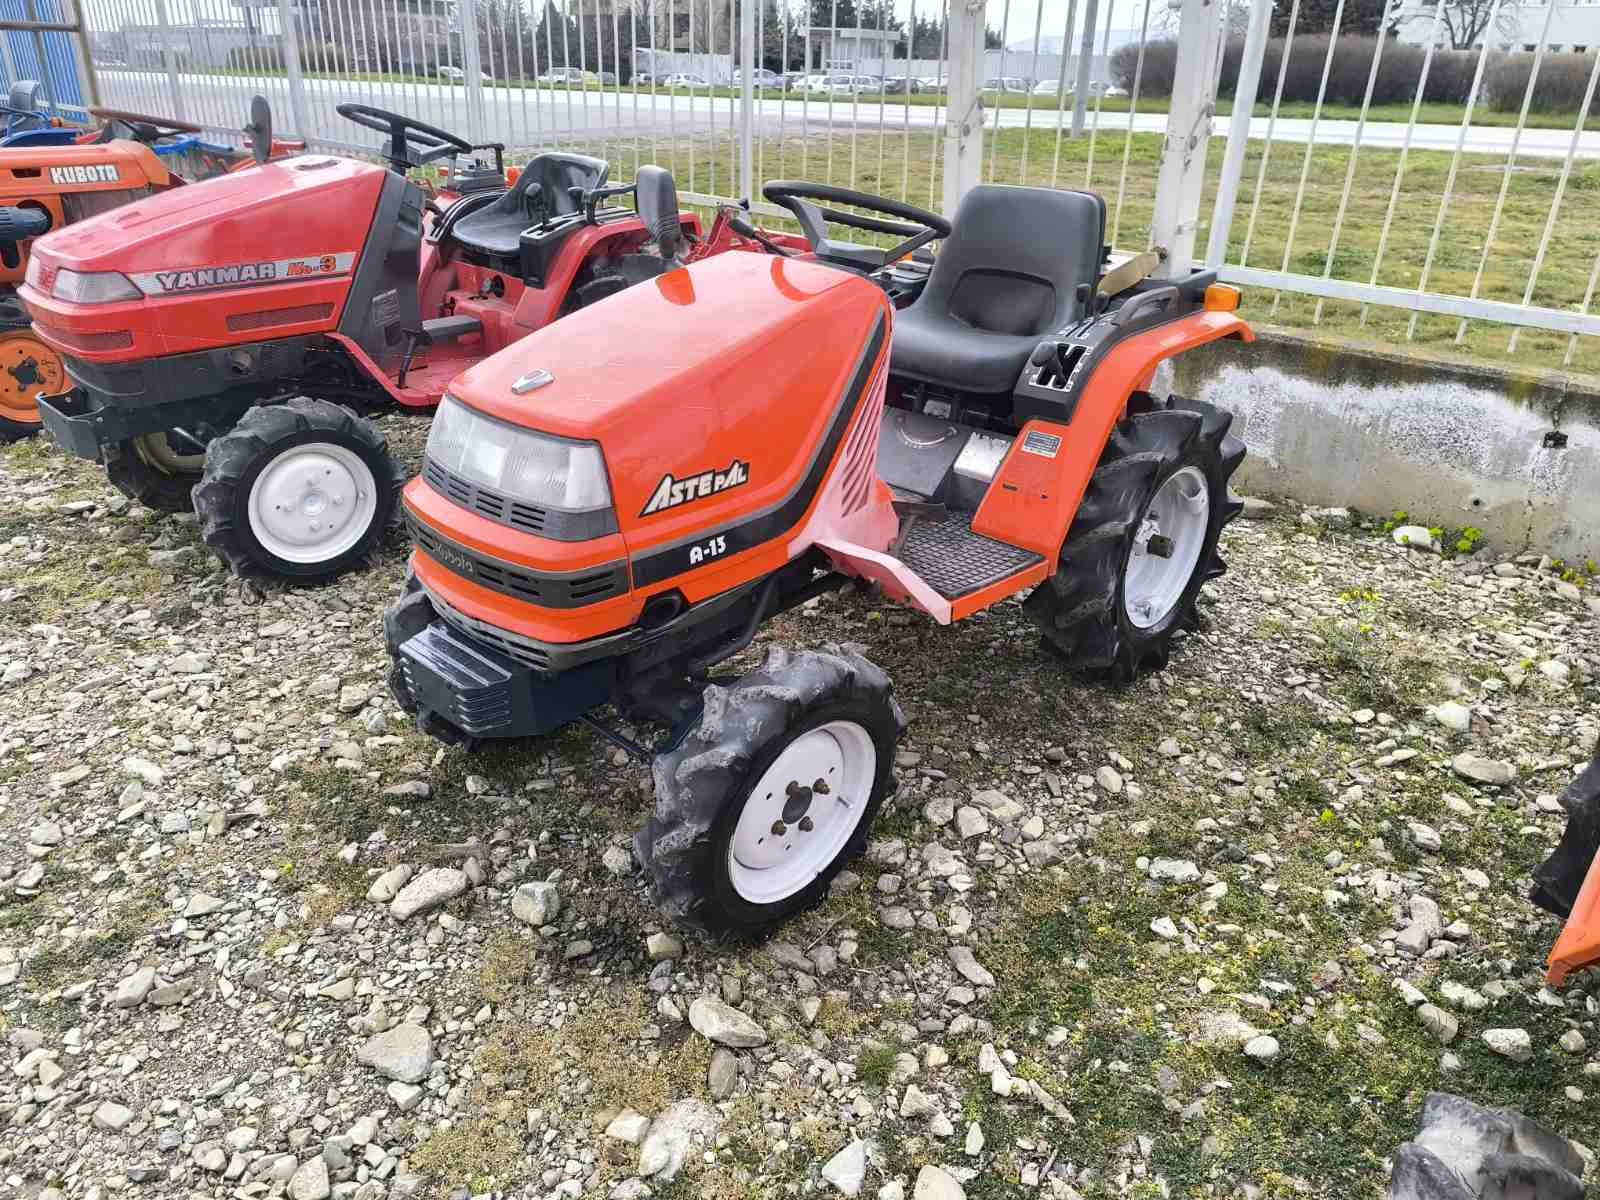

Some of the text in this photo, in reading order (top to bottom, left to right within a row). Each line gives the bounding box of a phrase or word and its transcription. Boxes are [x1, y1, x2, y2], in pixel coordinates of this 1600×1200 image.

[49, 164, 119, 184] KUBOTA
[157, 262, 276, 291] YANMAR
[689, 535, 727, 565] A-15
